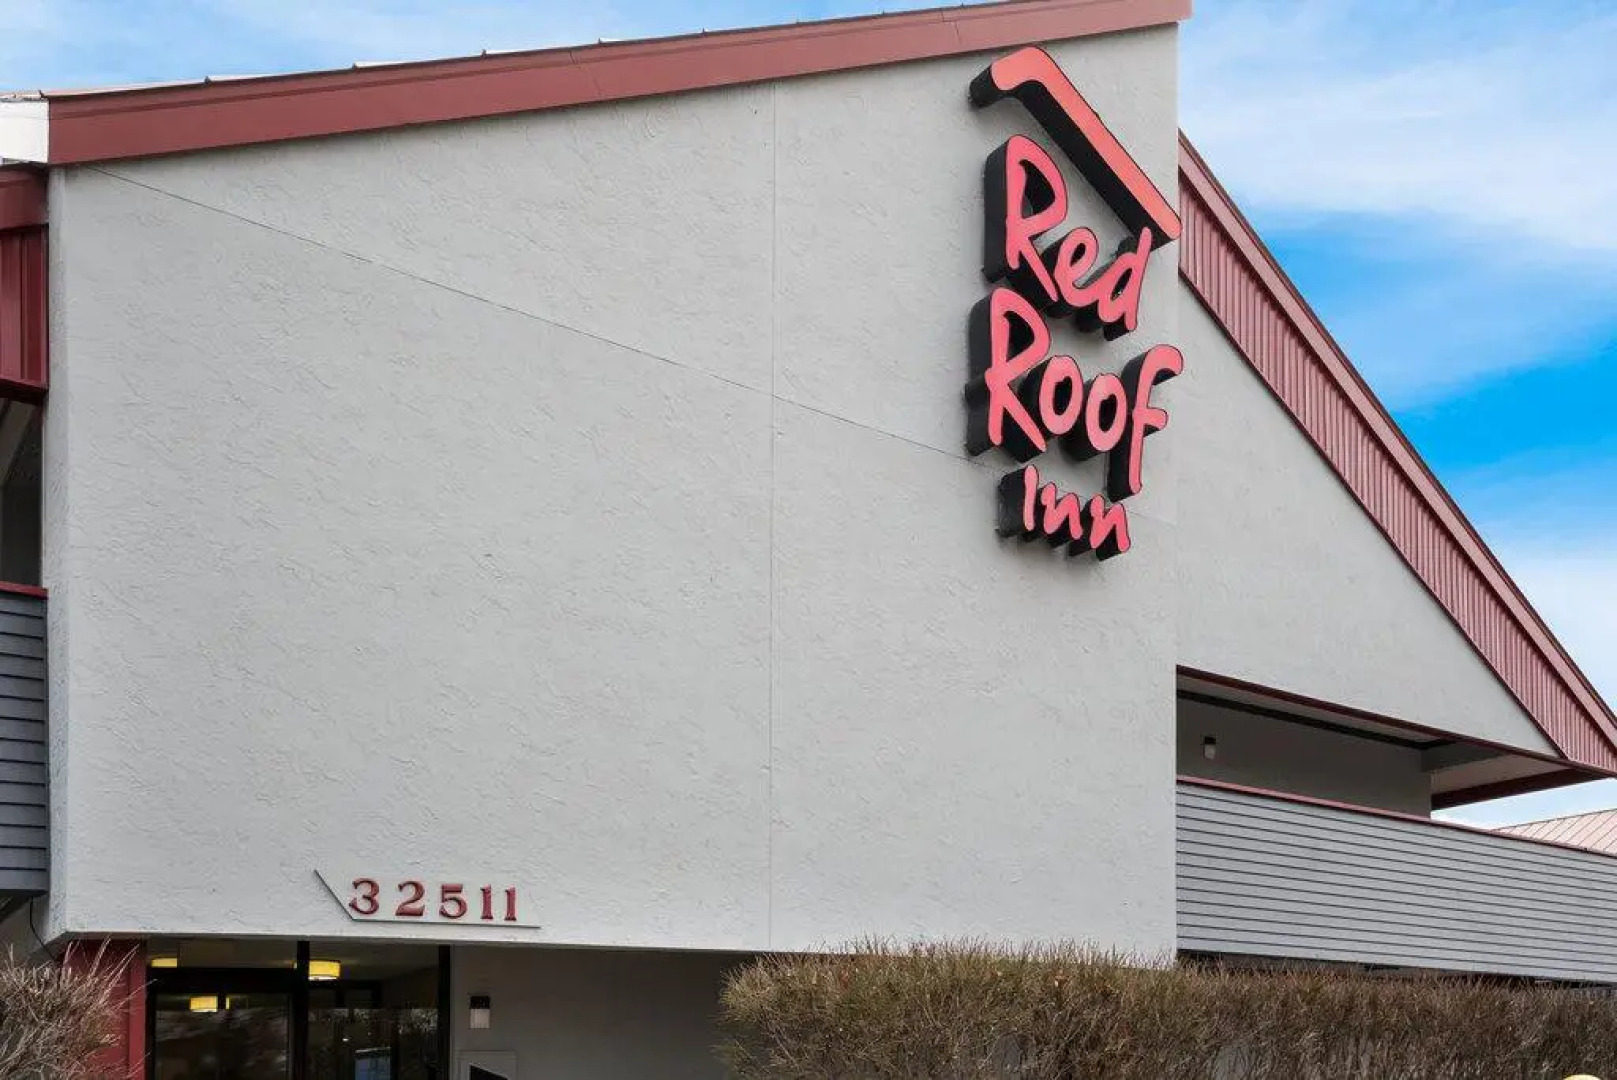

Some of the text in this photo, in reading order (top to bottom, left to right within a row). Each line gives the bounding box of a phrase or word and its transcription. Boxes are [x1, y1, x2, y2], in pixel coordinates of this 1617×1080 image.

[1005, 134, 1153, 332] Red
[985, 287, 1184, 495] Roof
[1023, 465, 1131, 553] Inn
[349, 877, 517, 922] 32511
